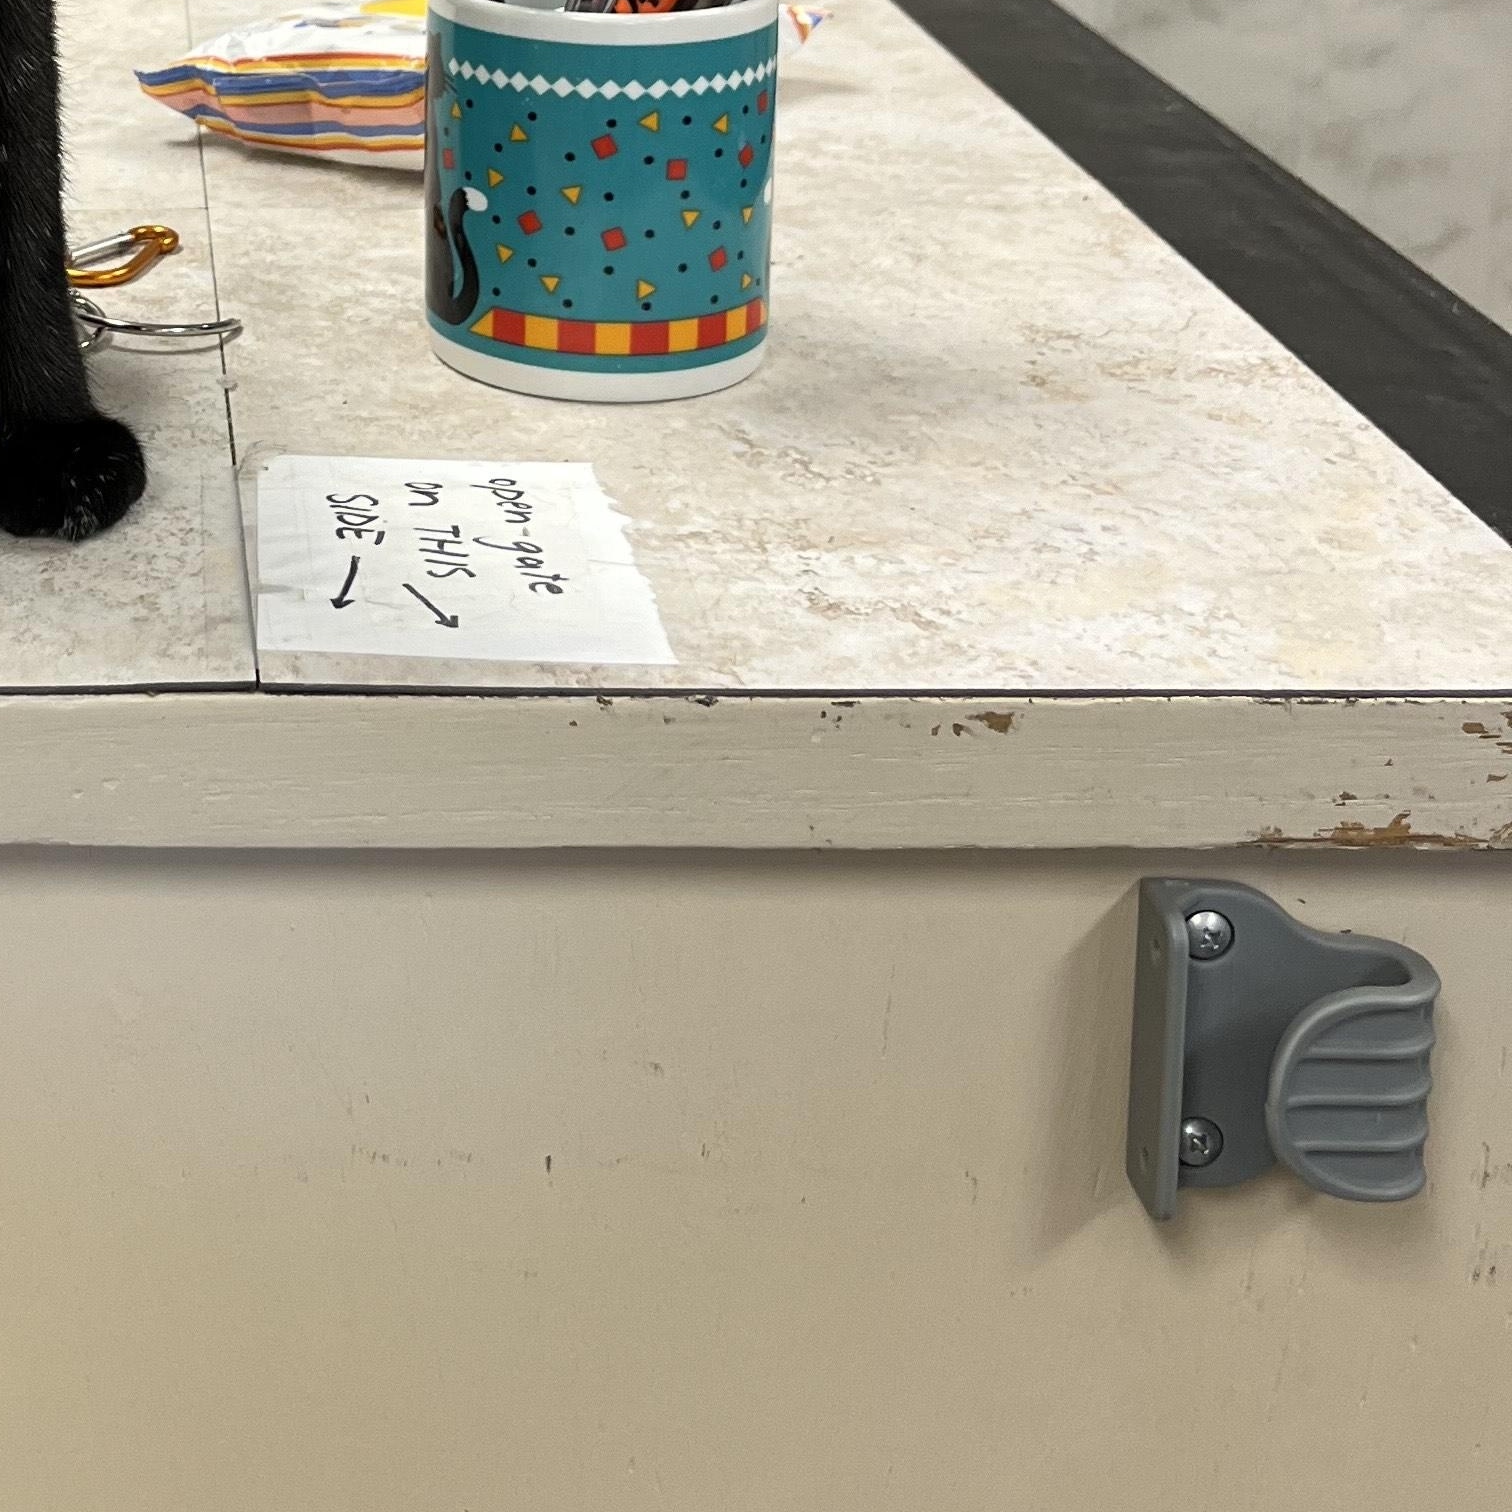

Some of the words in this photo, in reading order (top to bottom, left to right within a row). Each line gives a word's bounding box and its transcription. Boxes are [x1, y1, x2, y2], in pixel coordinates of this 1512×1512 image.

[326, 492, 386, 546] SIDE
[404, 481, 444, 507] on
[413, 524, 477, 579] THIS
